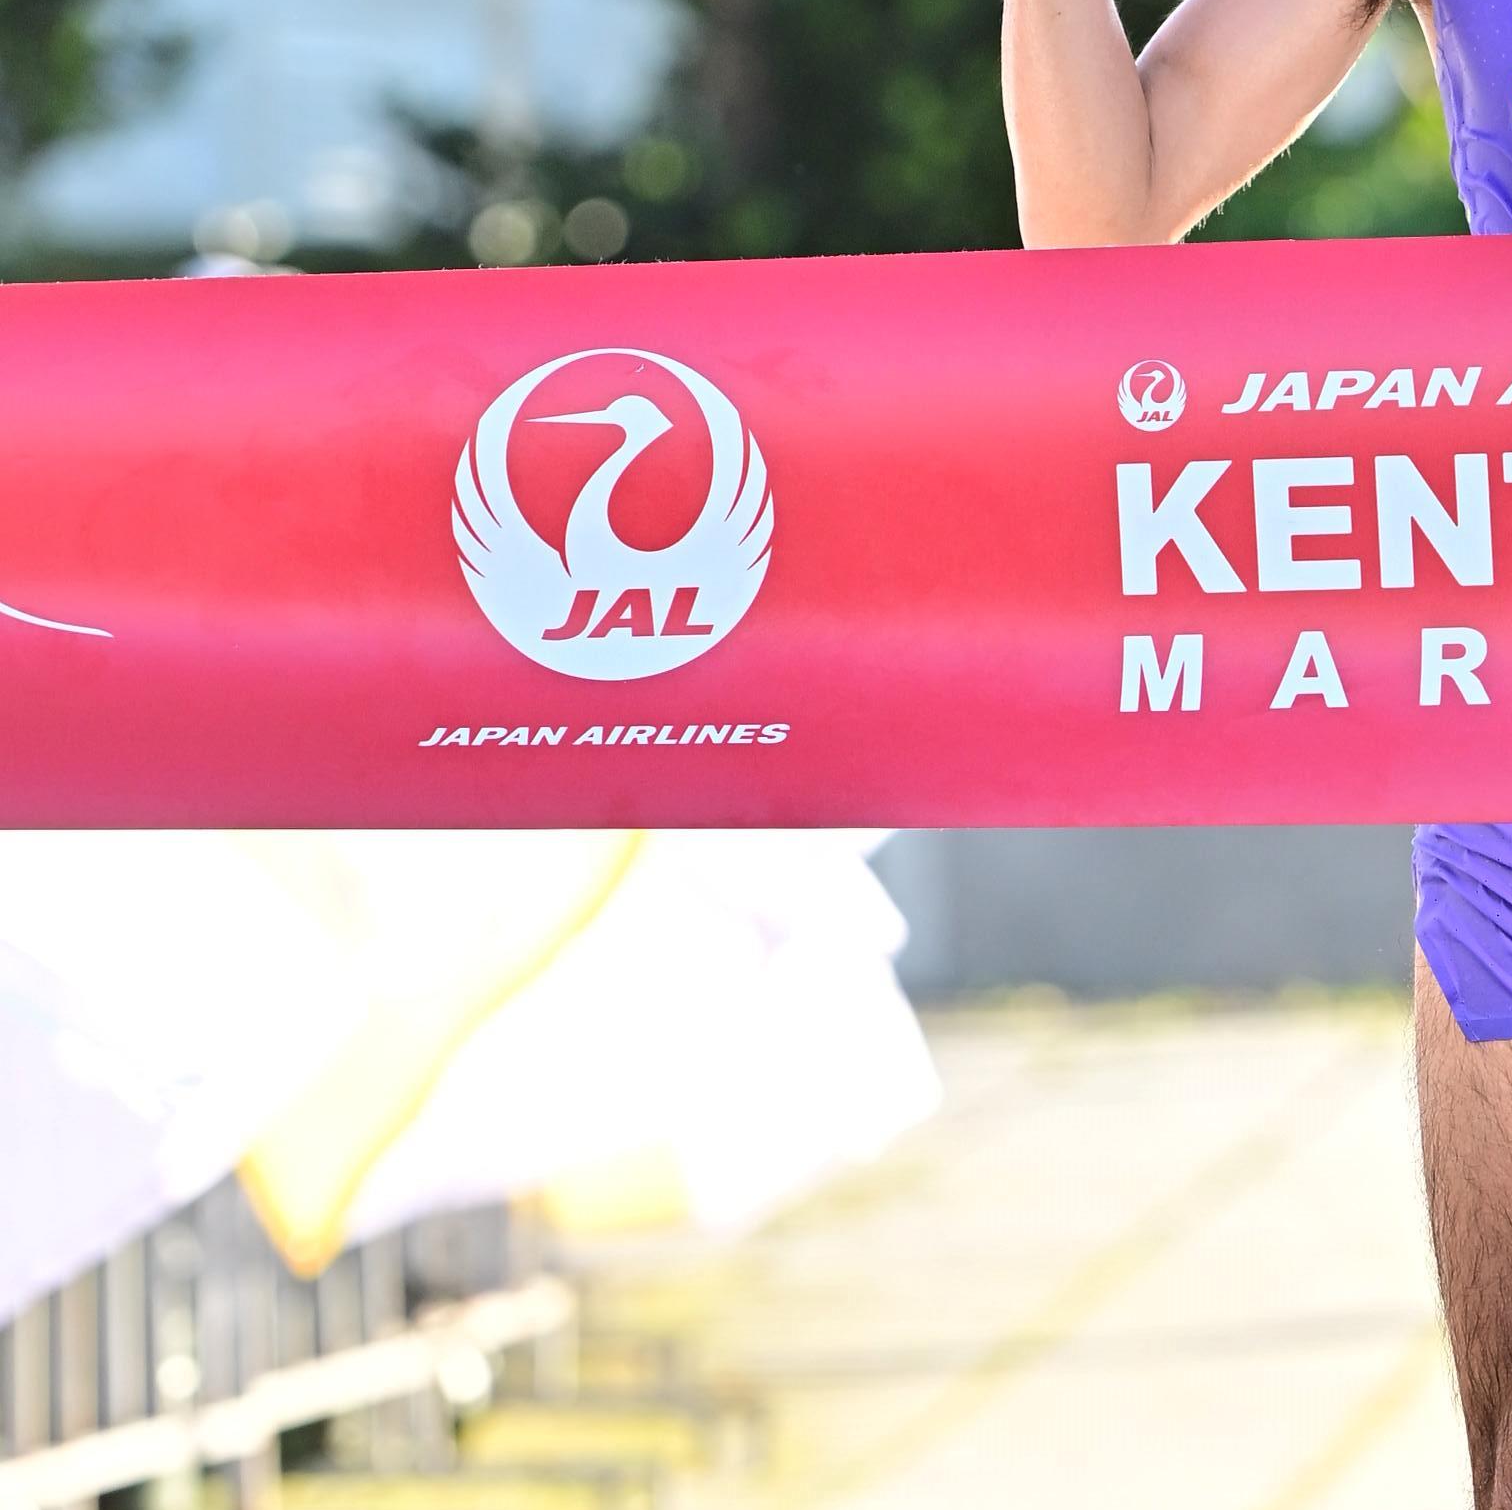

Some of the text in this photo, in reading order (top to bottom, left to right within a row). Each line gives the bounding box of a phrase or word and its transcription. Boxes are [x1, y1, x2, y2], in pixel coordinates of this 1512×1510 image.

[1221, 366, 1483, 414] JAPAN
[1136, 410, 1173, 423] JAL
[541, 586, 715, 641] JAL
[418, 723, 791, 747] JAPAN AIRLINES
